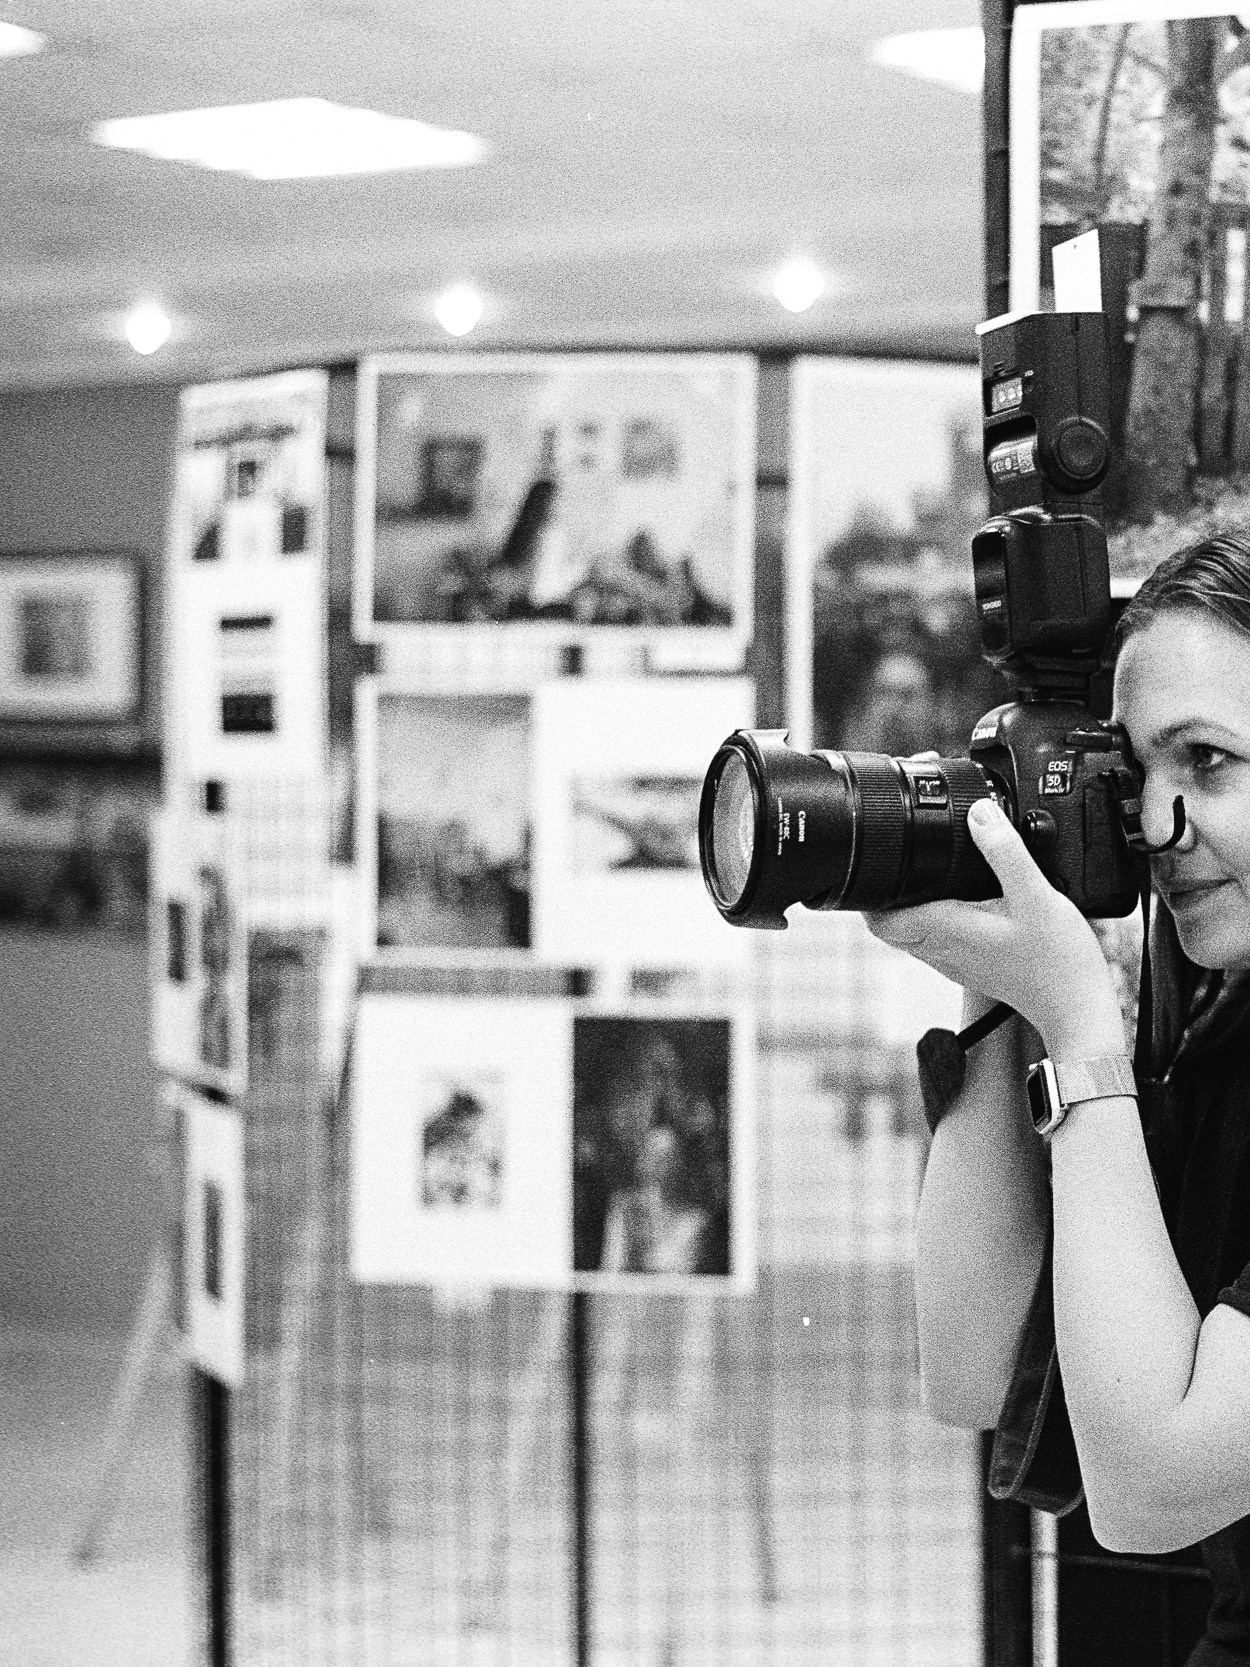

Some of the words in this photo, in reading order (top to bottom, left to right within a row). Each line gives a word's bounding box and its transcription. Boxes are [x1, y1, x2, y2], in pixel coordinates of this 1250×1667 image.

[971, 727, 998, 741] Canon
[1048, 760, 1068, 772] EOS
[1047, 775, 1061, 787] 5D
[798, 810, 806, 842] Canon
